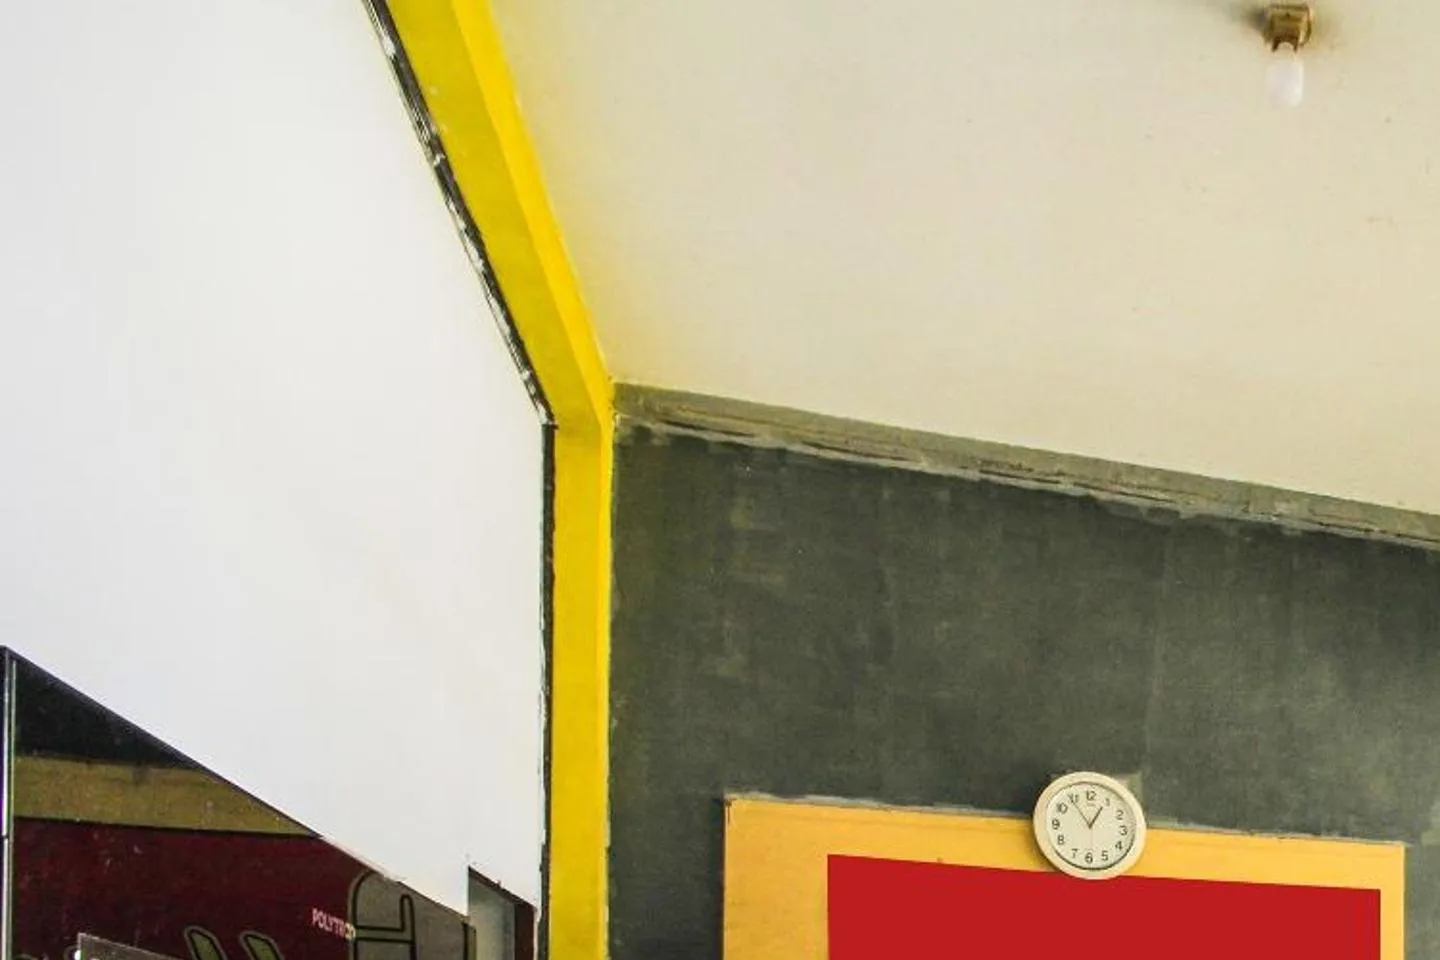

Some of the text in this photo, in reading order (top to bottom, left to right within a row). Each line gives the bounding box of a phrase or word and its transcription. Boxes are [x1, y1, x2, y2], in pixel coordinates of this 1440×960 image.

[1086, 791, 1096, 800] 12
[1056, 802, 1069, 814] 10
[1115, 810, 1124, 820] 2
[1052, 819, 1060, 830] 9
[1119, 825, 1128, 836] 3
[1057, 835, 1065, 845] 8
[1115, 841, 1123, 851] 4
[1071, 848, 1079, 859] 7
[1085, 852, 1094, 864] 6
[1101, 851, 1109, 861] 5
